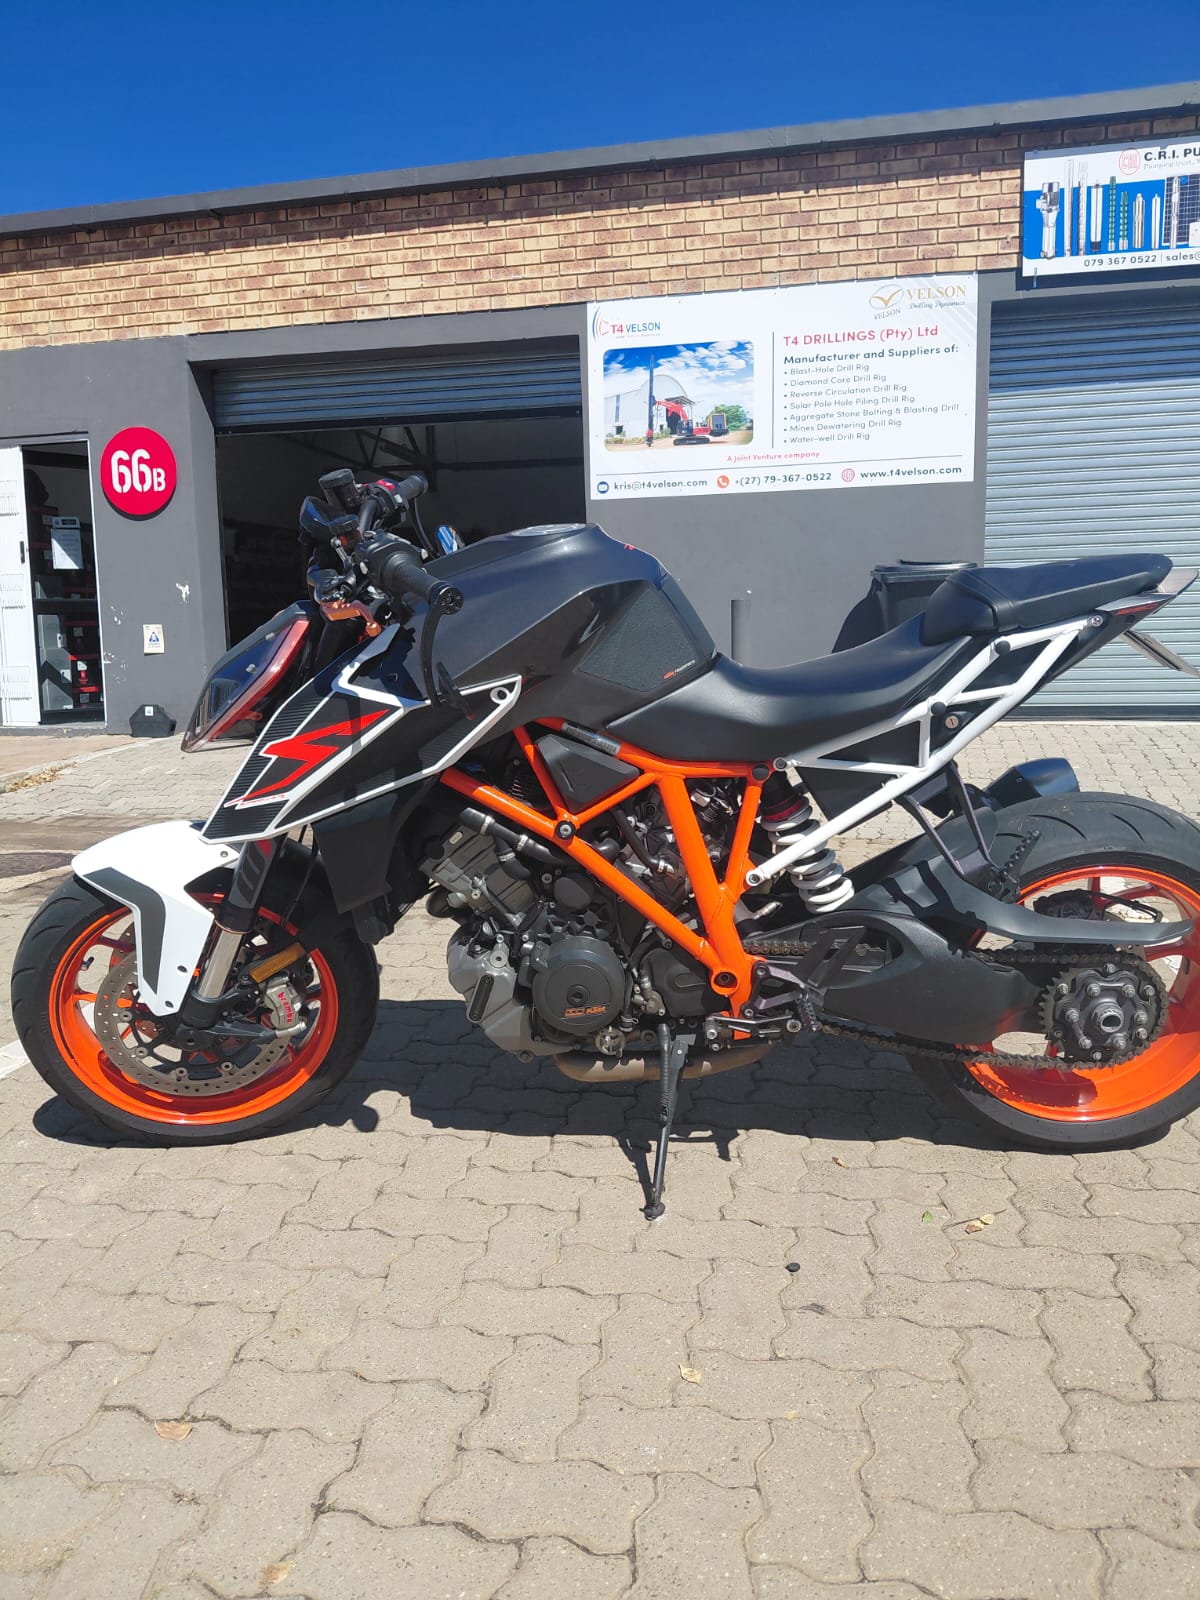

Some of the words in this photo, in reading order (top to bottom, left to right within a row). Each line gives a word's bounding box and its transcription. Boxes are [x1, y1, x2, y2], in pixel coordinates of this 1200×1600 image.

[1144, 149, 1179, 162] C.R.I.
[1083, 258, 1104, 267] 079
[1107, 256, 1127, 266] 367
[1130, 254, 1157, 264] 0522
[906, 285, 967, 301] VELSON
[873, 308, 901, 320] VELSON
[611, 324, 624, 334] T4
[625, 321, 661, 333] VELSON
[783, 336, 799, 347] T4
[803, 330, 876, 346] DRILLINGS
[879, 327, 913, 342] (Pty)
[917, 325, 939, 337] Ltd
[783, 352, 861, 365] Manufacturer
[863, 349, 885, 359] and
[888, 346, 941, 359] Suppliers
[944, 344, 959, 353] of:
[790, 365, 834, 376] Blast-Hole
[836, 362, 854, 372] Drill
[856, 363, 870, 372] Rig
[790, 377, 829, 387] Diamond
[830, 375, 851, 385] Core
[853, 374, 871, 383] Drill
[873, 374, 887, 383] Rig
[790, 389, 823, 398] Reverse
[825, 385, 871, 397] Circulation
[873, 384, 891, 393] Drill
[893, 384, 907, 393] Rig
[790, 401, 811, 410] Solar
[814, 399, 832, 409] Pole
[834, 398, 854, 407] Hole
[855, 396, 879, 406] Piling
[881, 395, 899, 404] Drill
[901, 395, 915, 404] Rig
[790, 411, 835, 422] Aggregate
[836, 409, 861, 419] Stone
[903, 405, 939, 415] Blasting
[941, 403, 959, 412] Drill
[790, 423, 815, 433] Mines
[817, 420, 866, 431] Dewatering
[868, 419, 886, 428] Drill
[888, 419, 902, 428] Rig
[790, 434, 835, 444] Water-well
[837, 432, 854, 441] Drill
[856, 432, 870, 441] Rig
[734, 454, 752, 463] Joint
[752, 452, 783, 461] Venture
[783, 451, 821, 461] company
[110, 448, 166, 494] 66B
[614, 479, 708, 491] kris@t4velson.com
[735, 475, 761, 487] +(27)
[764, 472, 832, 484] 79-367-0522
[860, 465, 962, 479] www.t4velson.com
